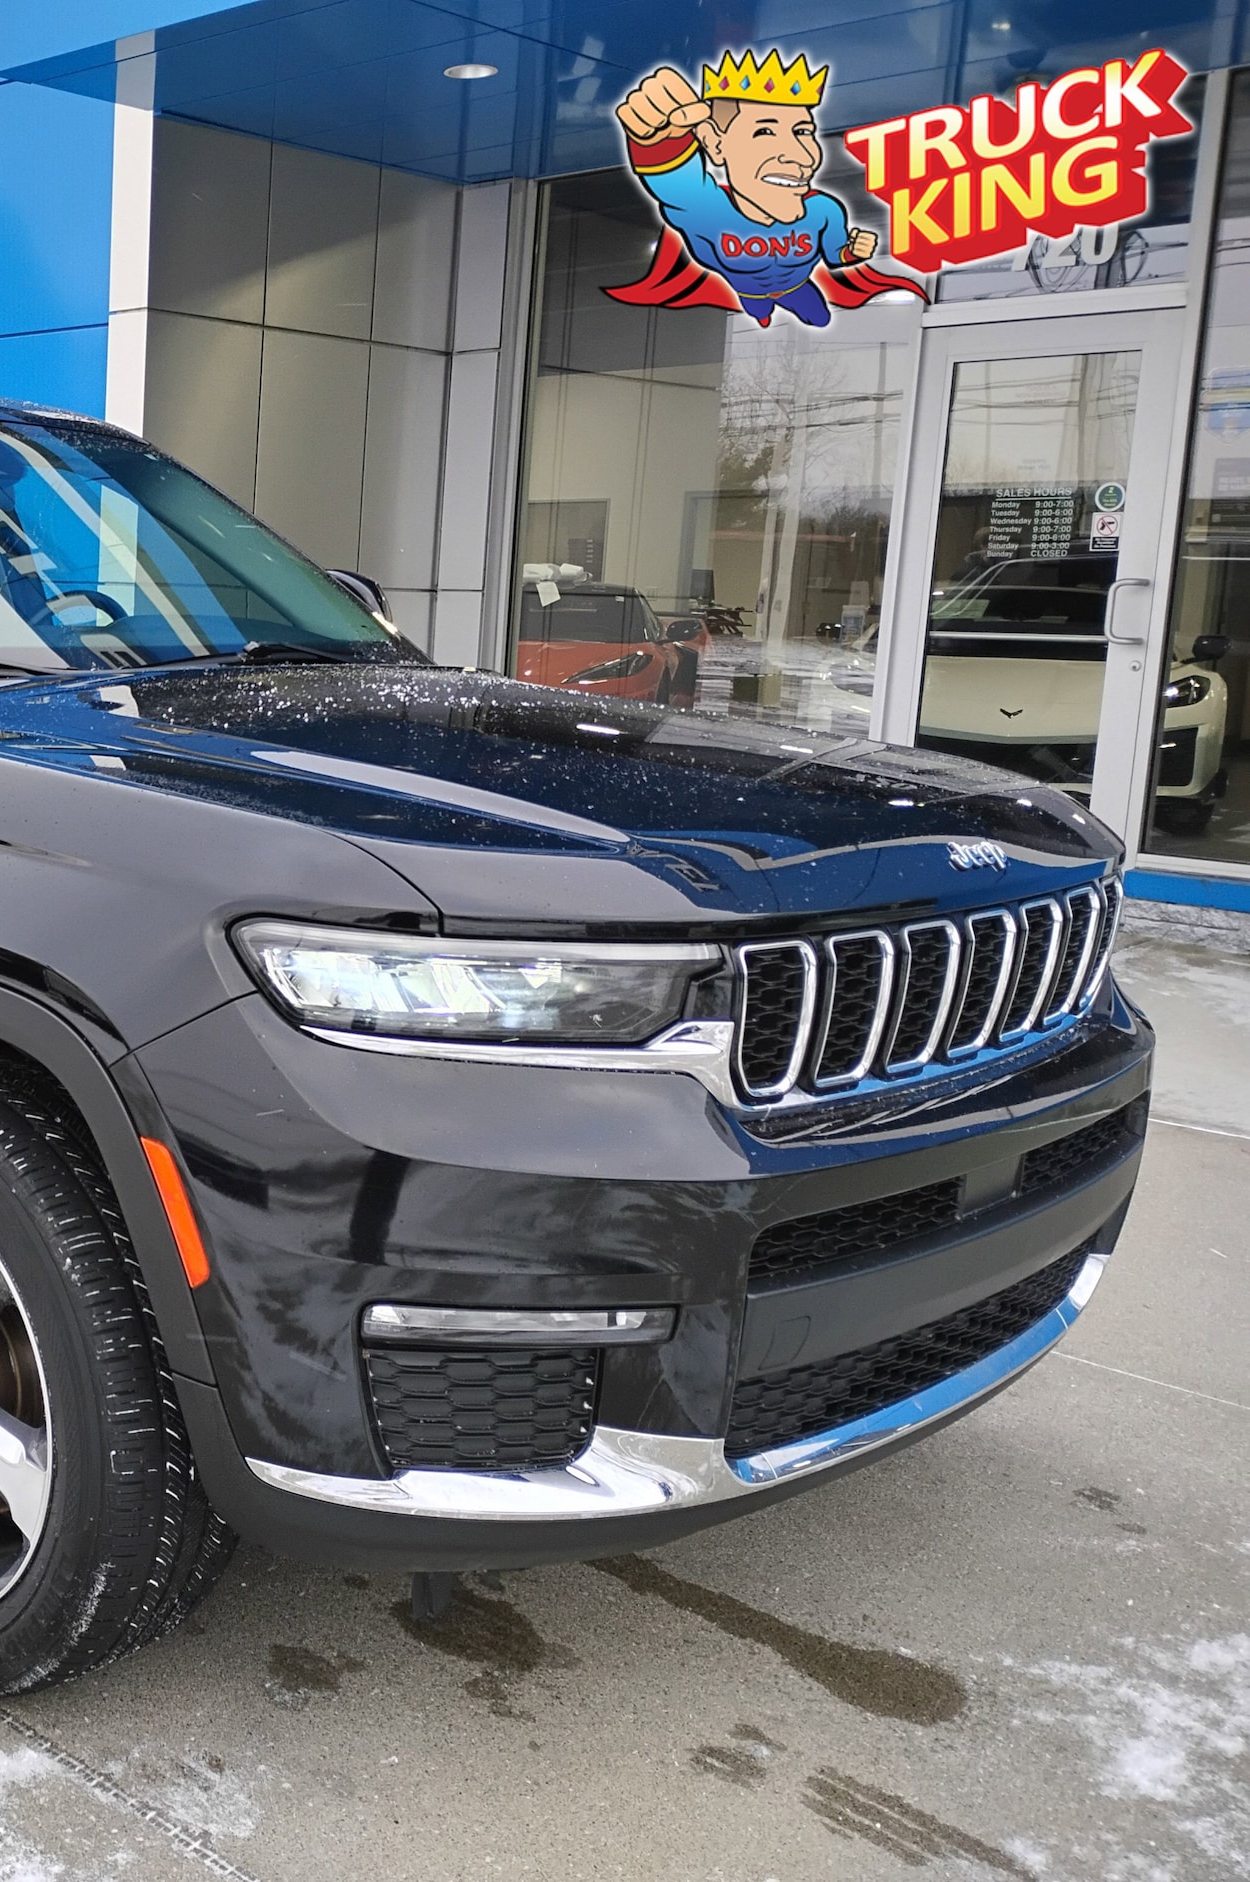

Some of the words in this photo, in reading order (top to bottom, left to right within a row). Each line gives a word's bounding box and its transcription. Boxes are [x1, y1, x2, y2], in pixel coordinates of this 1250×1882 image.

[996, 488, 1031, 498] SALES
[1033, 487, 1072, 497] HOURS
[1035, 500, 1074, 508] 9:00-7:00
[990, 518, 1032, 526] Wednesday
[1033, 517, 1072, 525] 9:00-6:00
[990, 526, 1022, 534] Thursday
[1032, 525, 1071, 533] 9:00-7:00
[988, 534, 1011, 542] Friday
[986, 551, 1013, 559] Sunday
[1030, 549, 1068, 557] CLOSED
[948, 841, 1007, 870] Jeep
